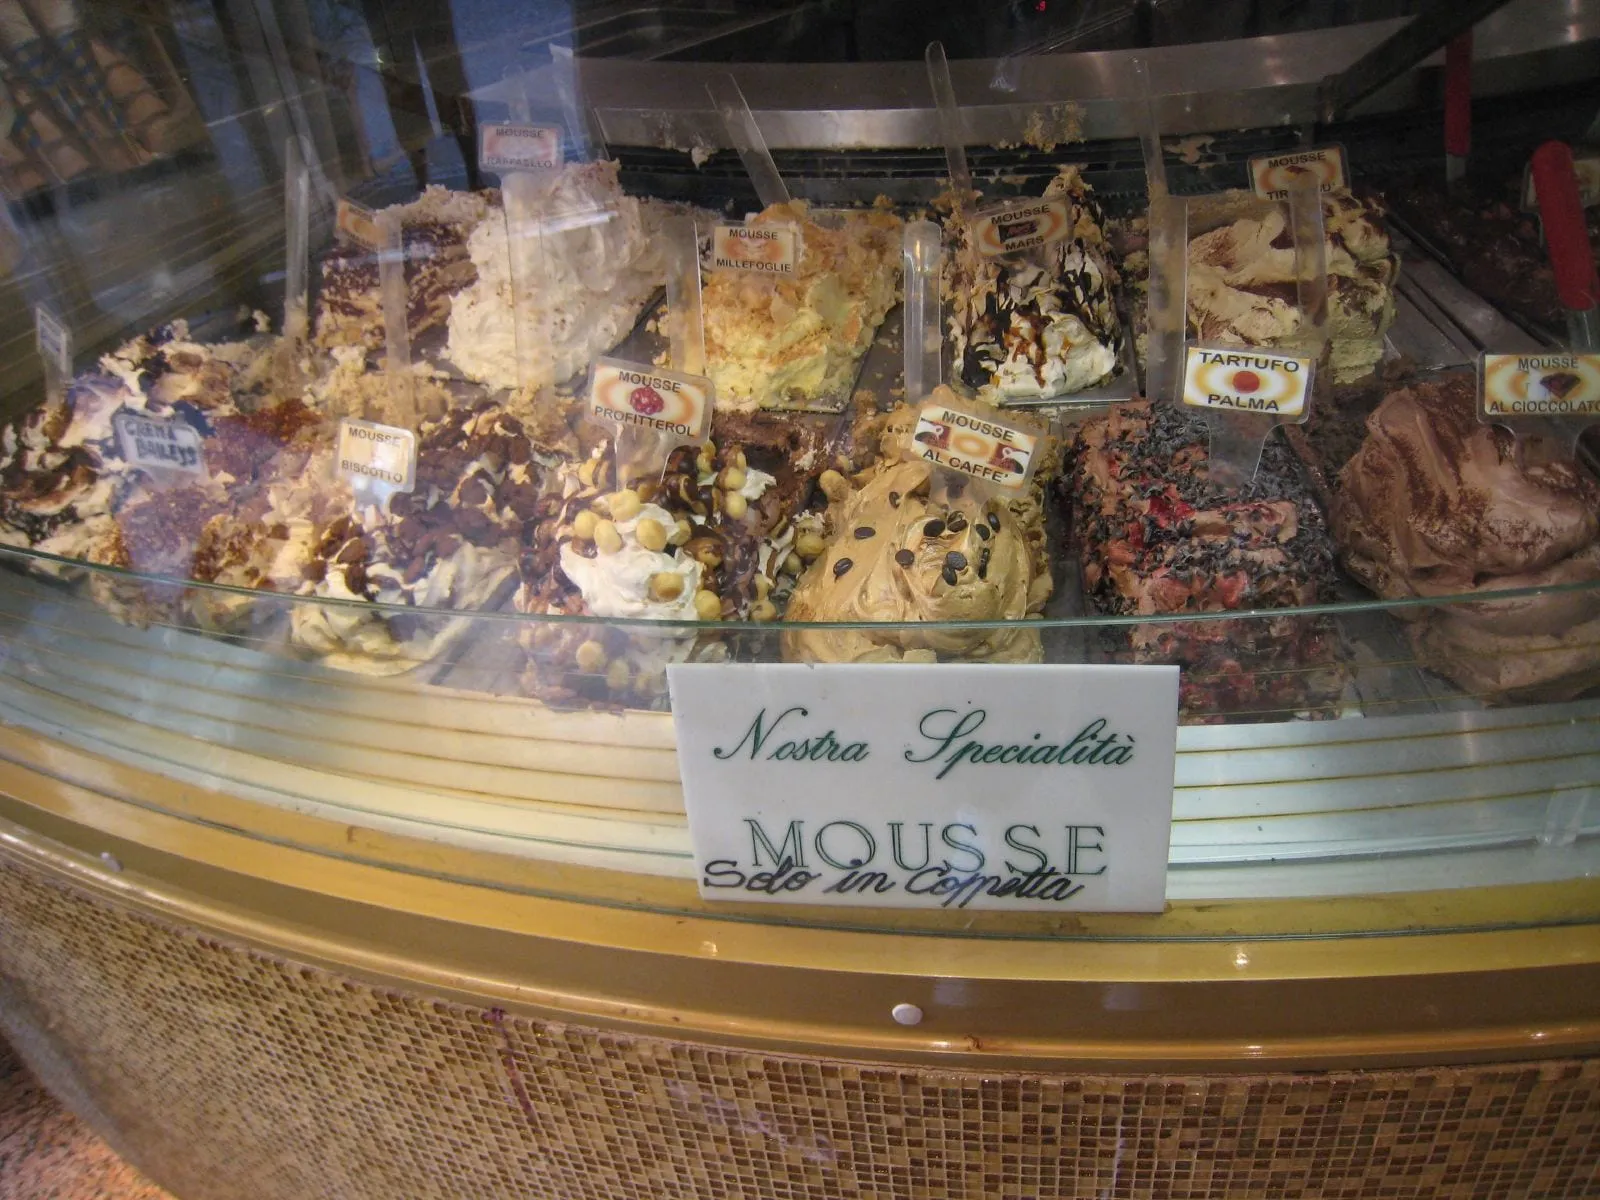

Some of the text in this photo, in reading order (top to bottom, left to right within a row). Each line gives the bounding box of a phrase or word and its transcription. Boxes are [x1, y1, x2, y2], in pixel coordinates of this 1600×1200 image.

[496, 127, 545, 138] MOUSSE
[1268, 151, 1326, 168] MOUSSE
[991, 204, 1051, 225] MOUSSE
[729, 228, 778, 240] MOUSSE
[1005, 235, 1044, 251] MARS
[716, 258, 792, 273] MILLEFOGLIE
[1199, 351, 1300, 373] TARTUFO
[1517, 357, 1579, 370] MOUSSE
[618, 371, 681, 393] MOUSSE
[1208, 393, 1280, 412] PALMA
[1490, 400, 1509, 413] AL
[594, 405, 696, 437] PROFITTEROL
[942, 410, 1015, 442] MOUSSE
[349, 427, 402, 448] MOUSSE
[341, 460, 403, 483] BISCOTTO
[923, 448, 1009, 483] AL CAFFE'
[713, 707, 1135, 780] Nostra Specialità
[743, 819, 1108, 876] MOUSSE
[822, 859, 898, 894] in
